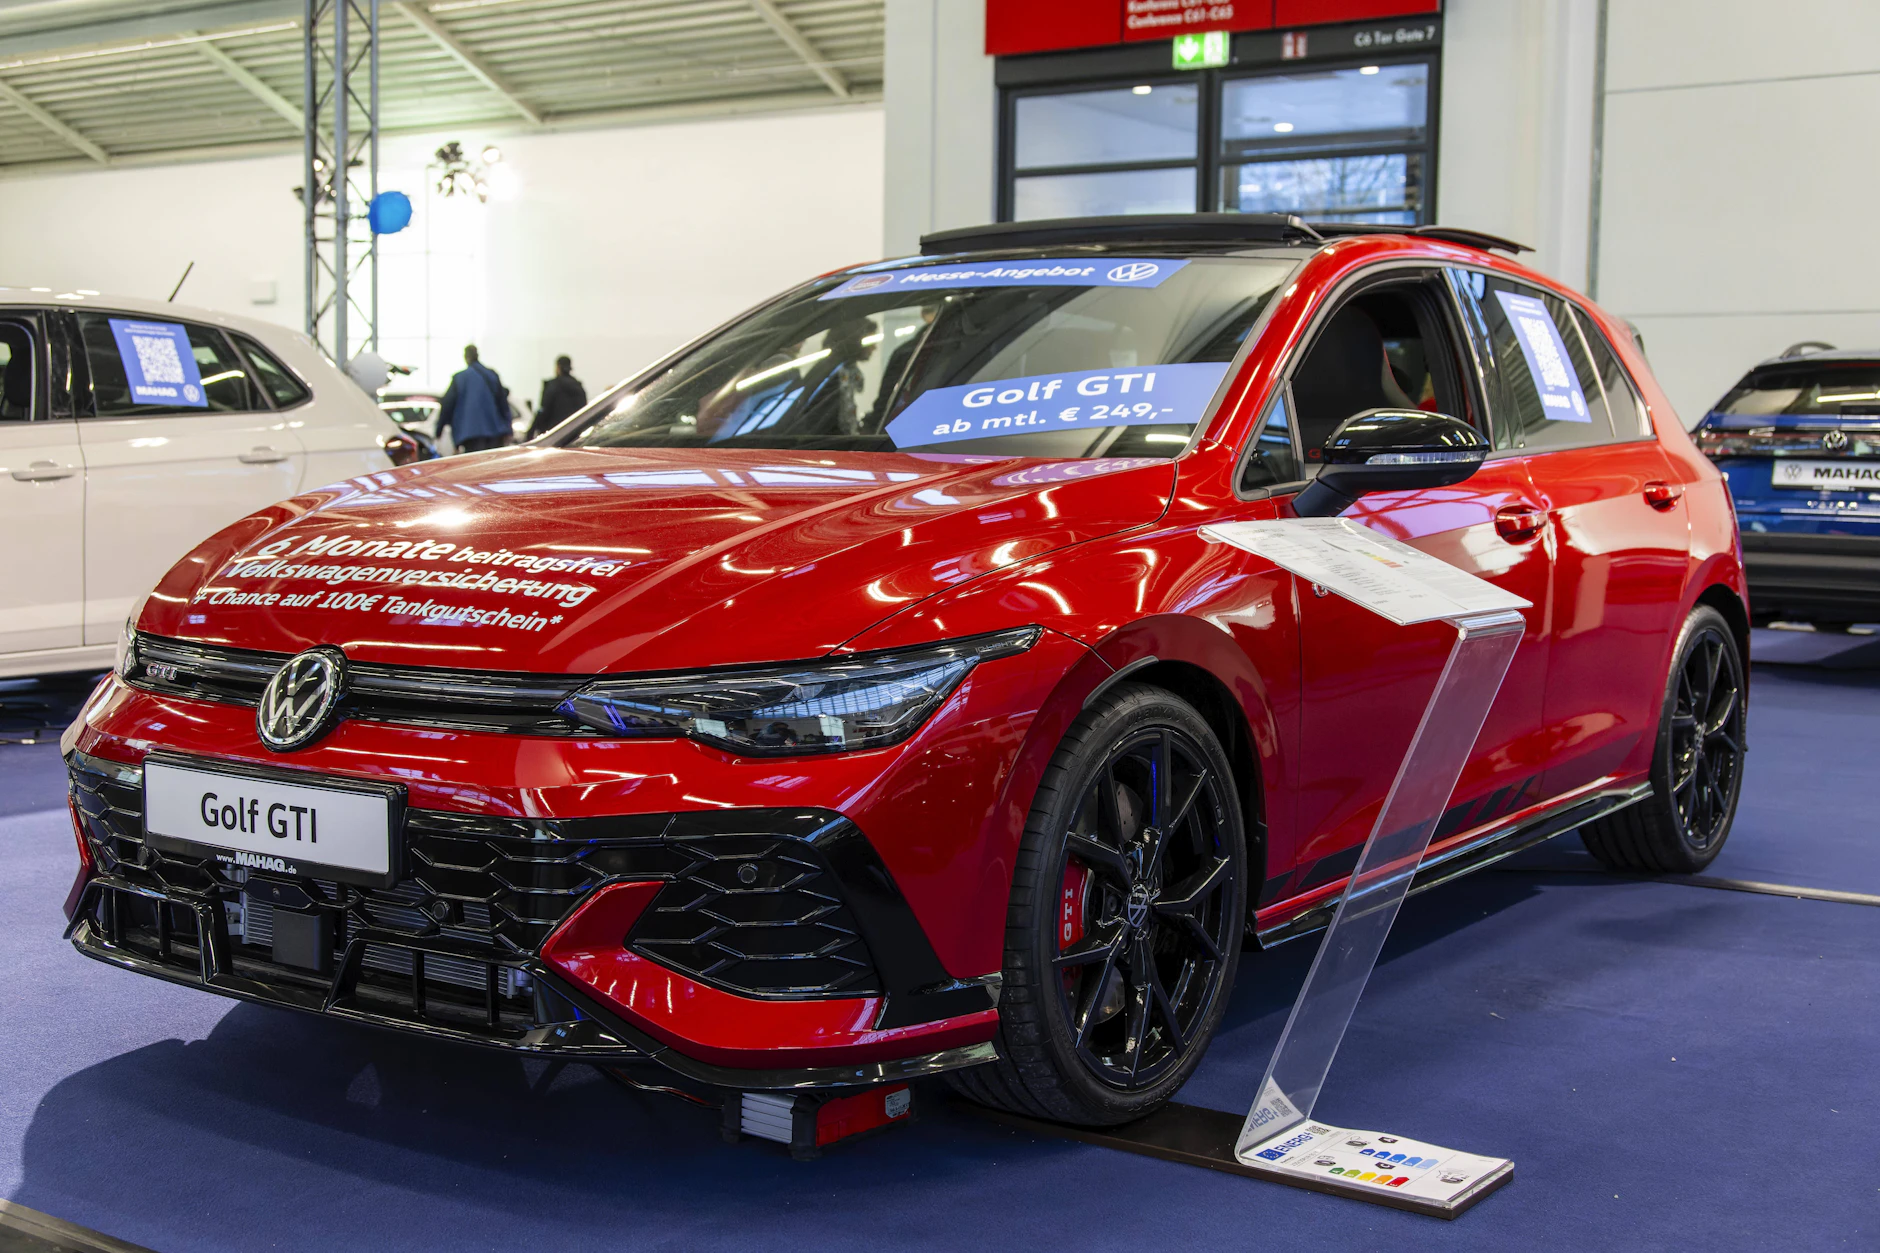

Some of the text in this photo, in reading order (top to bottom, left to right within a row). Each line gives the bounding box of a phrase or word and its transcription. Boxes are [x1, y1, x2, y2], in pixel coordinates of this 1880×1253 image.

[900, 266, 1096, 284] Messe-Angebot
[962, 372, 1156, 408] Golf GTI
[932, 402, 1174, 436] ab mtl. € 249,-
[257, 535, 632, 577] 6 Monate beitragsfrei
[208, 588, 283, 605] Chance
[278, 590, 325, 608] auf
[317, 592, 384, 612] 100€
[226, 559, 597, 608] Volkswagenversicherung
[145, 662, 178, 680] GTI
[200, 792, 317, 844] Golf GTI
[216, 851, 297, 875] www.MAHAG.de
[1064, 888, 1073, 941] GTI
